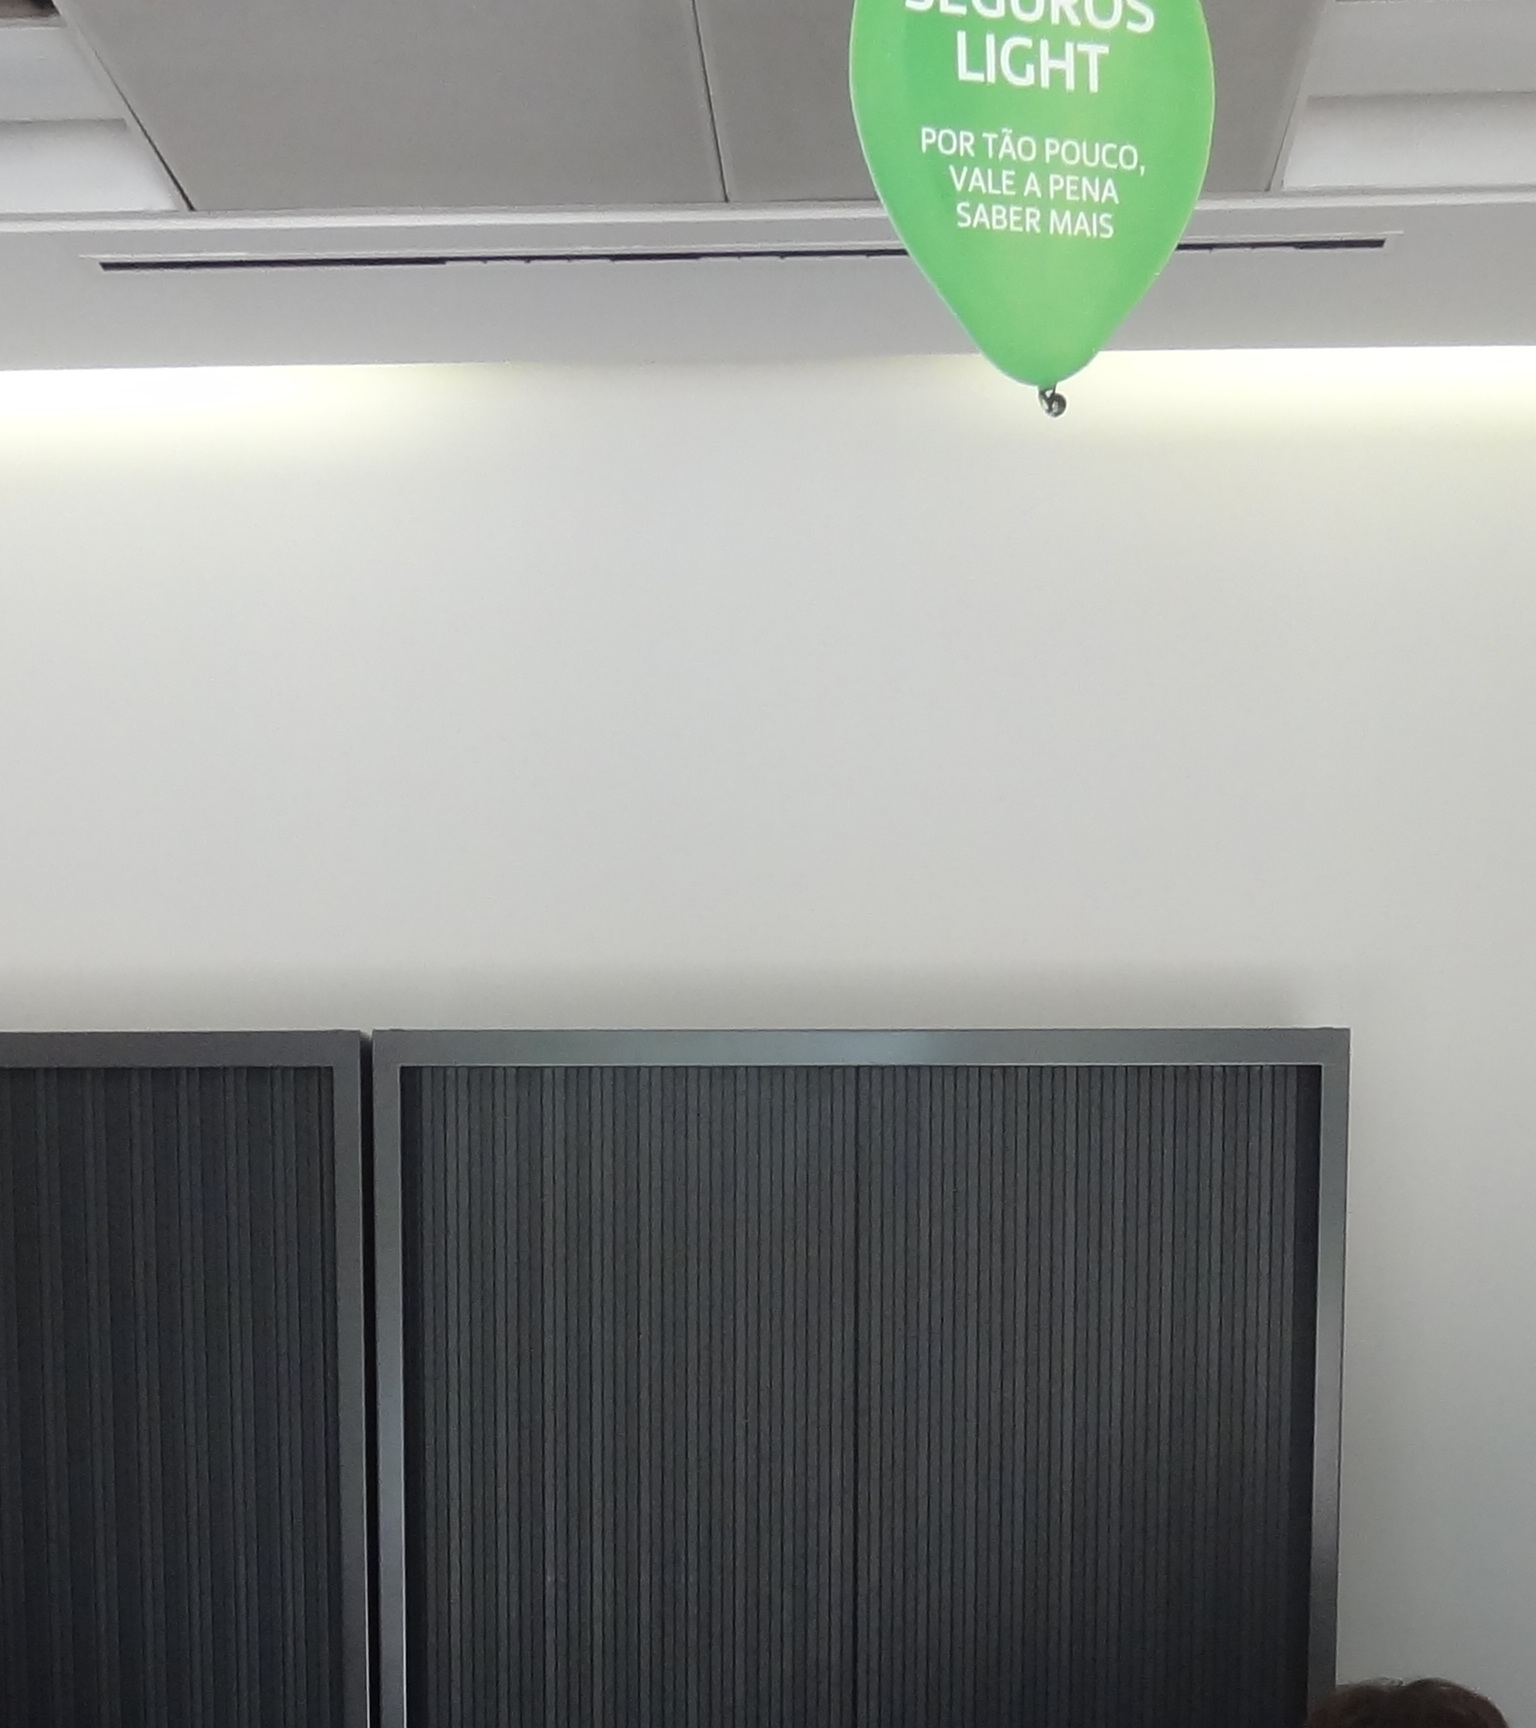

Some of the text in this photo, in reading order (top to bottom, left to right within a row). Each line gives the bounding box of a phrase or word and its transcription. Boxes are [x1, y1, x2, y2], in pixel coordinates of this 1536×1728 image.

[957, 30, 1110, 93] LIGHT
[920, 126, 1146, 177] POR TÃO POUCO,
[949, 164, 1120, 205] VALE A PENA
[956, 201, 1114, 239] SABER MAIS
